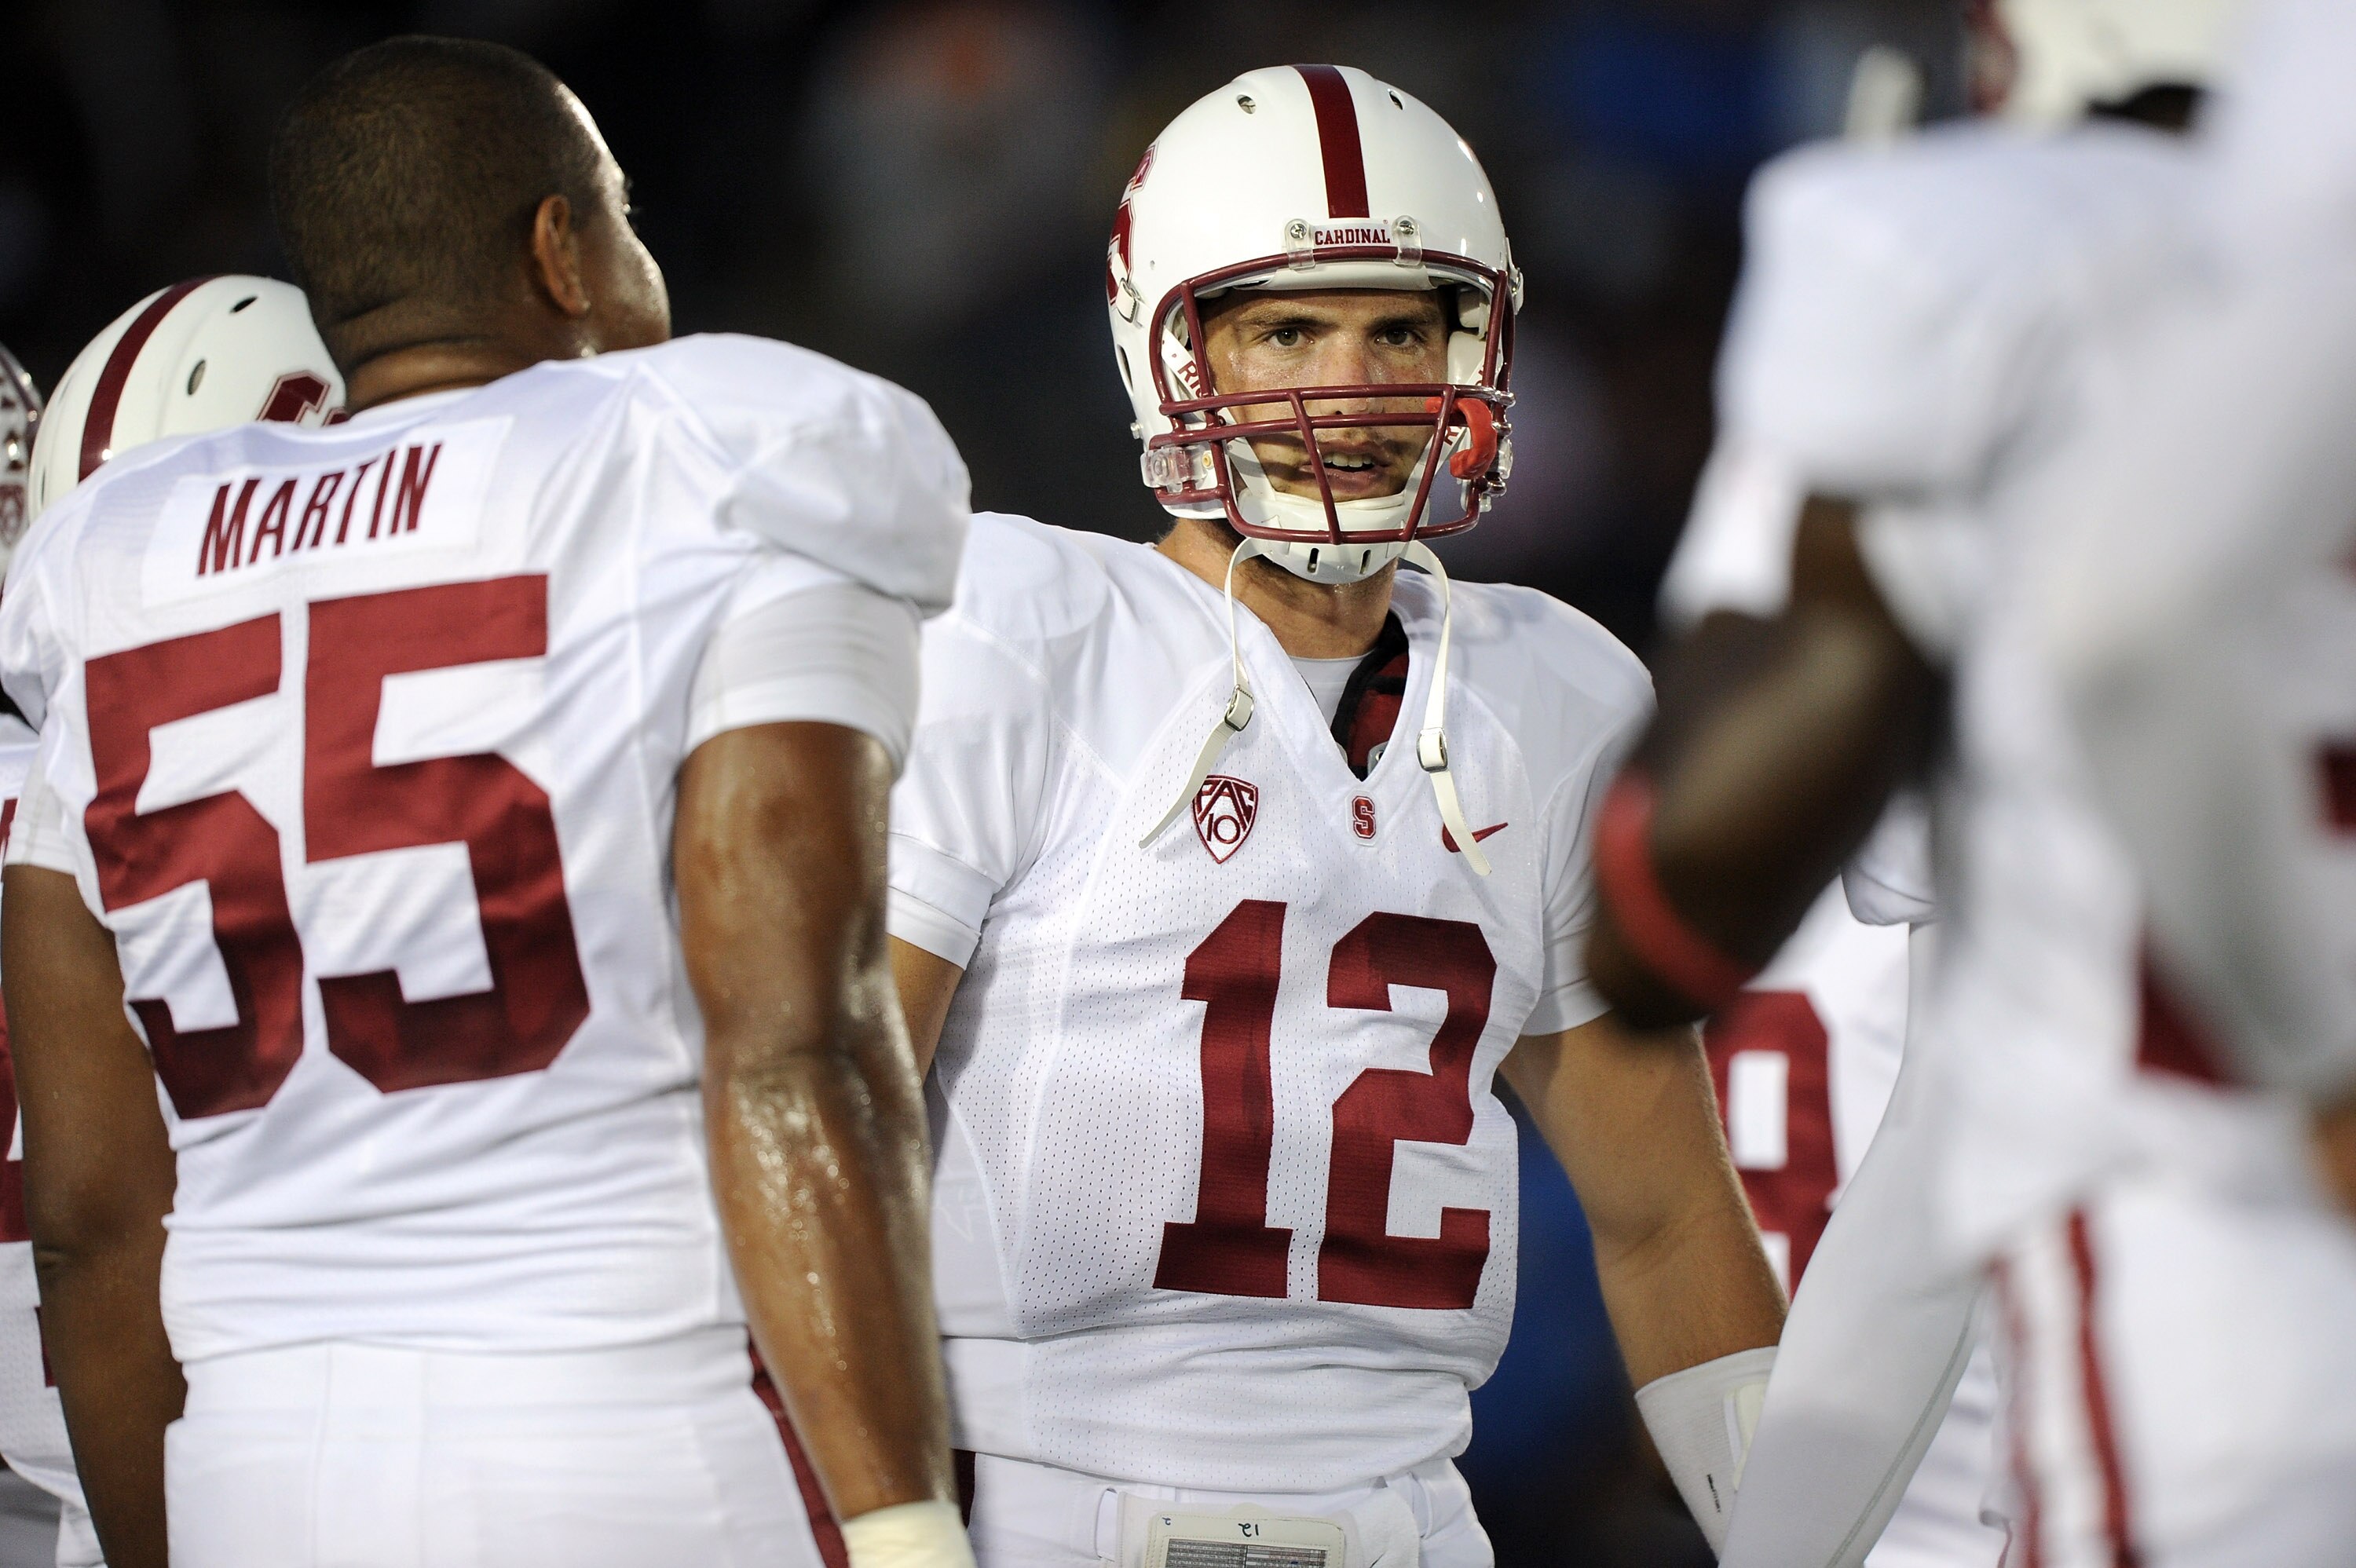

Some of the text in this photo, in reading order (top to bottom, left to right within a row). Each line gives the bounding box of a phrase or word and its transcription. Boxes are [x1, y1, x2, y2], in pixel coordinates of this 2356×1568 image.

[1314, 228, 1391, 245] CARDINAL
[198, 442, 443, 577] MARTIN
[1194, 779, 1256, 832] PAC
[1206, 813, 1241, 844] 10
[1351, 795, 1377, 839] S
[85, 573, 591, 1120] 55
[1153, 899, 1497, 1310] 12
